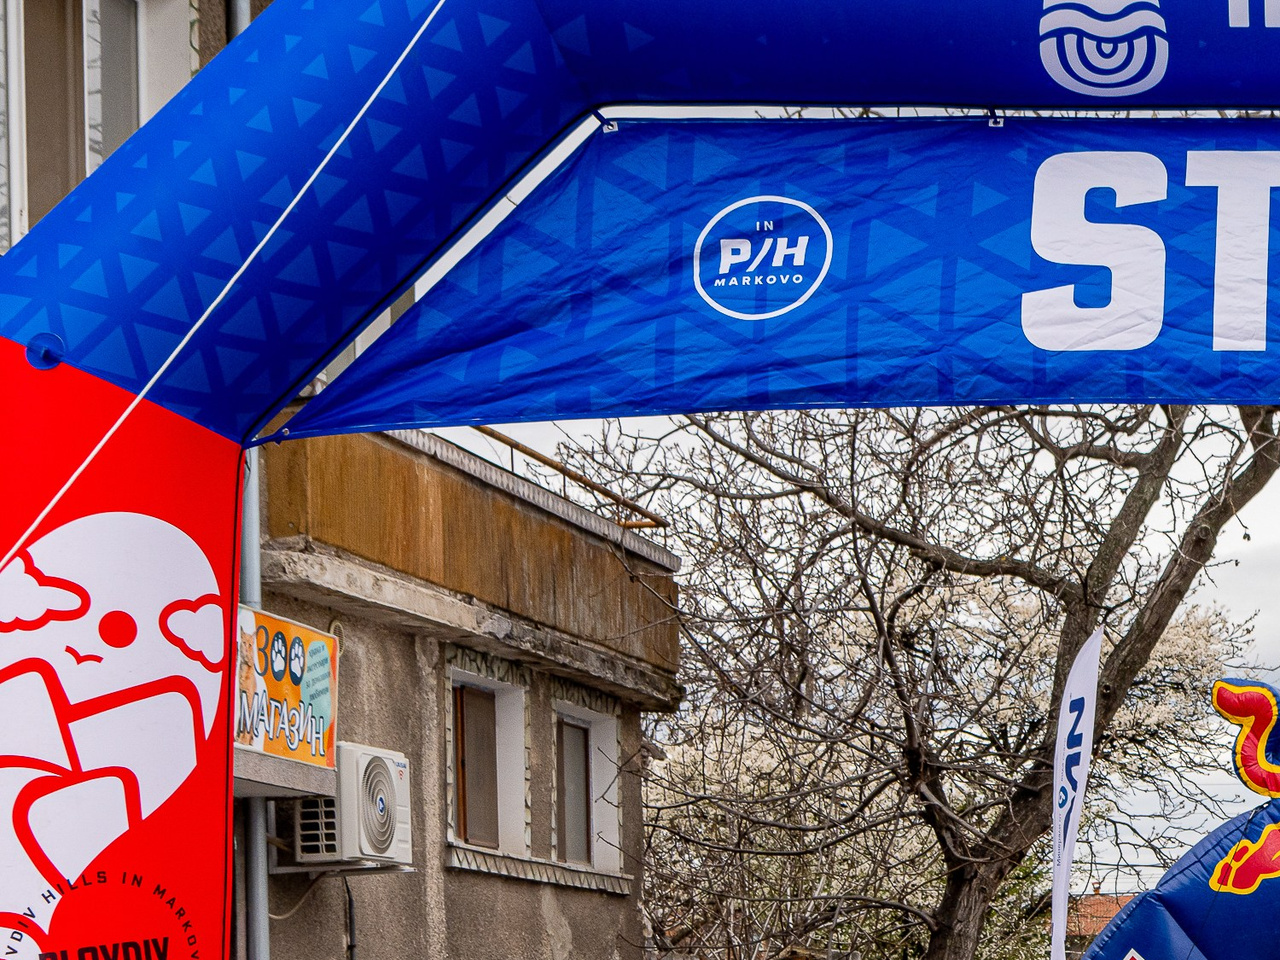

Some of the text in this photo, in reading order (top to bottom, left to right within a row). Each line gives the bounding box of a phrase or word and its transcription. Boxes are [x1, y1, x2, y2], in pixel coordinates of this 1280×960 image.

[755, 220, 775, 232] IN
[718, 235, 810, 275] P/H
[713, 274, 804, 287] MARKOVO
[238, 690, 326, 757] МАГАЗИН
[41, 871, 108, 904] HILLS
[121, 871, 143, 888] IN
